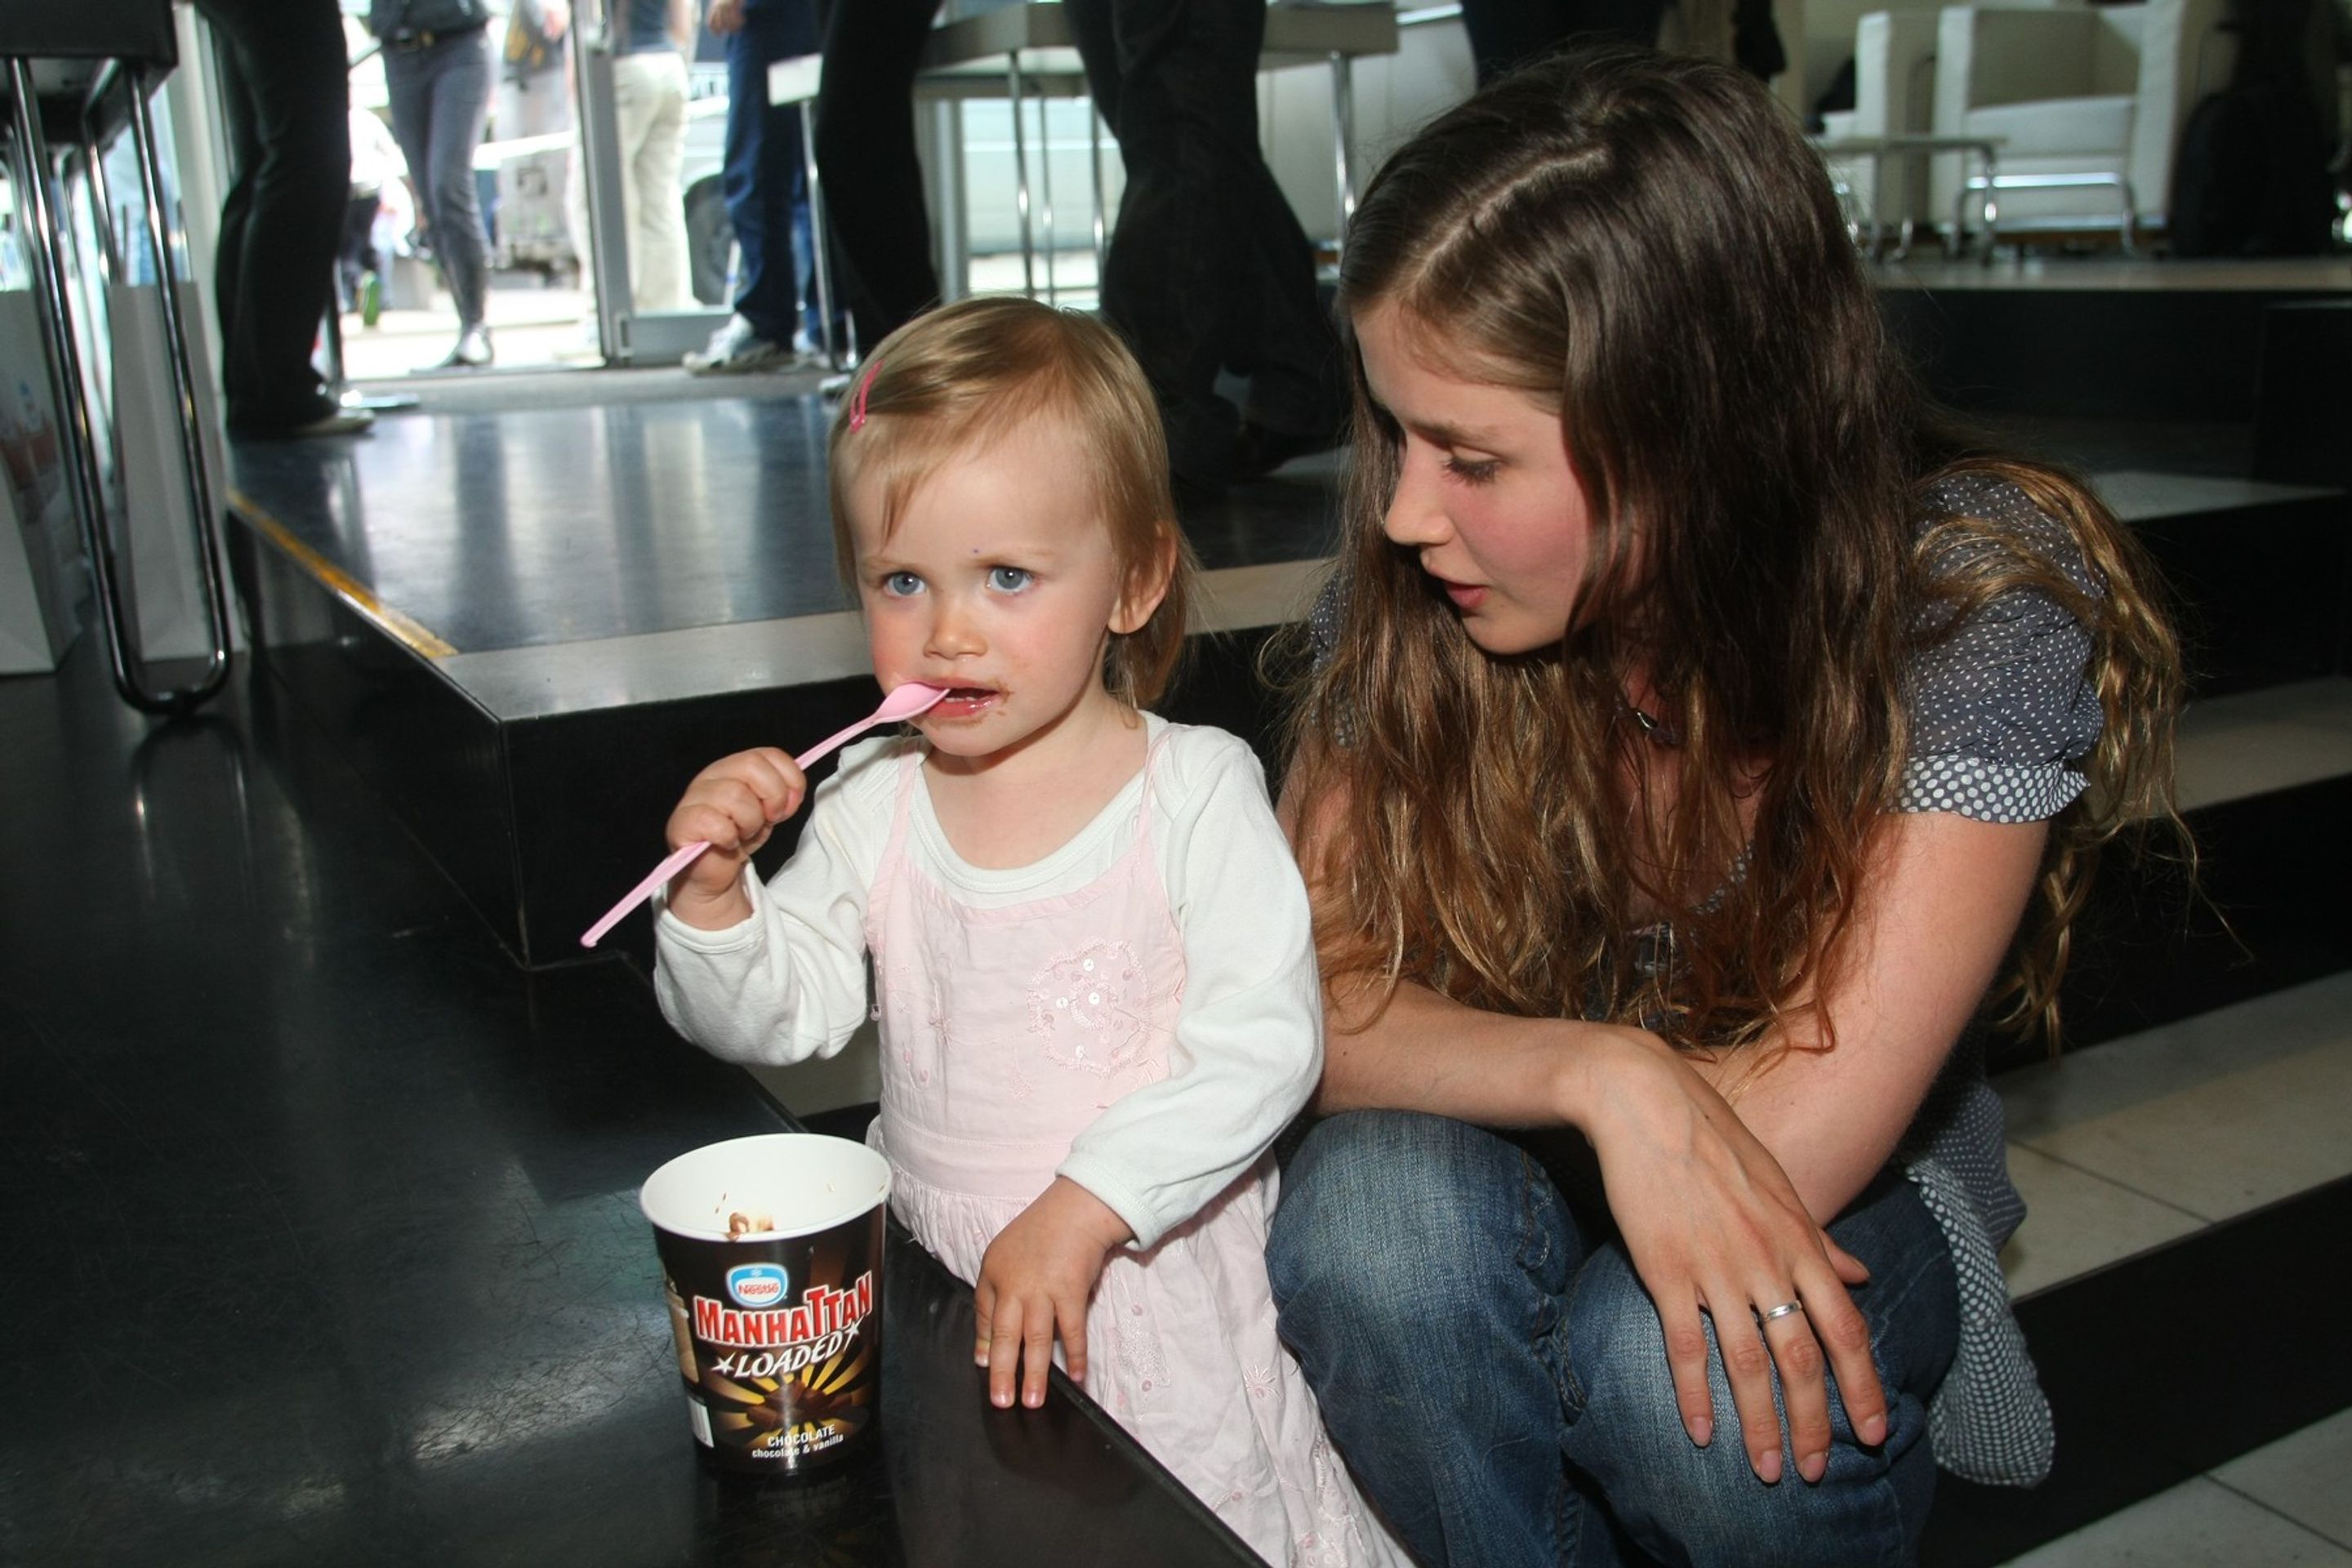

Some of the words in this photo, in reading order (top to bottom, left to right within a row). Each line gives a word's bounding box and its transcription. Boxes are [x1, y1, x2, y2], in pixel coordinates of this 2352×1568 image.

[693, 1270, 872, 1348] MANHATTAN
[734, 1331, 843, 1378] LOADED
[768, 1423, 835, 1447] CHOCOLATE
[802, 1444, 811, 1454] &
[813, 1434, 844, 1451] vanilla
